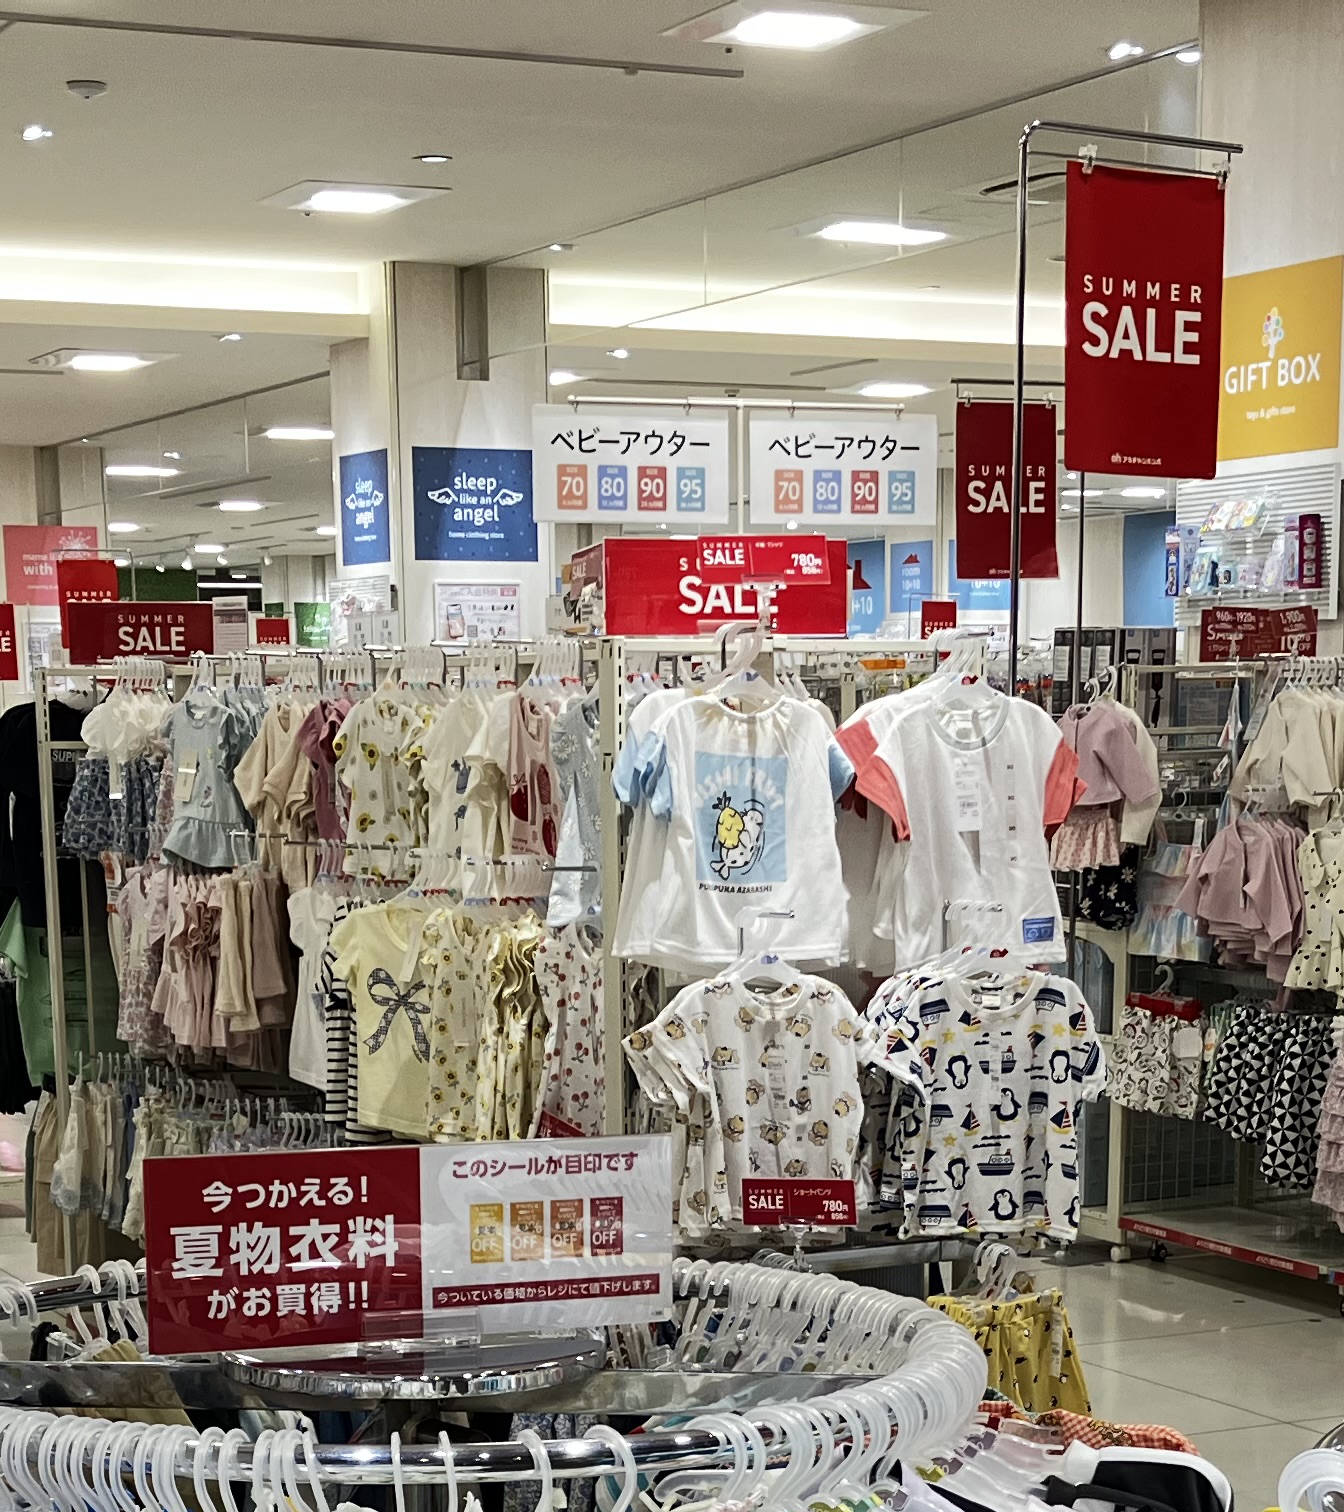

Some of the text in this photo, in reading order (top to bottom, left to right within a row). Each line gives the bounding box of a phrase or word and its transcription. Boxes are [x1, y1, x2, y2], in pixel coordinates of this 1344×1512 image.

[1084, 274, 1203, 304] SUMMER
[1081, 301, 1203, 365] SALE
[1224, 352, 1321, 395] GIFT BOX
[551, 427, 710, 457] ベビーアウター
[768, 433, 920, 461] ベビーアウター
[968, 465, 1045, 477] SUMER
[454, 472, 497, 494] sleep
[560, 476, 703, 499] 70 80 90 95
[777, 481, 912, 501] 70 80 90 95
[459, 493, 492, 505] like an
[454, 505, 500, 526] angel
[702, 541, 744, 550] SUMMER
[702, 549, 745, 565] SALE
[791, 553, 822, 568] 780円
[24, 563, 53, 576] with
[901, 567, 920, 576] room
[901, 578, 921, 590] 10+10
[678, 575, 779, 615] SALE
[118, 614, 185, 624] SUMMER
[118, 626, 186, 651] SALE
[452, 1151, 638, 1180] このシールが目印です
[202, 1176, 368, 1213] 今つかえる!
[748, 1195, 784, 1209] SALE
[822, 1200, 848, 1212] 780円
[170, 1213, 399, 1280] 夏物衣料
[471, 1239, 499, 1252] OFF
[512, 1235, 537, 1249] OFF
[552, 1233, 577, 1248] OFF
[592, 1231, 617, 1245] OFF
[208, 1281, 369, 1319] がお買得!!
[437, 1279, 655, 1304] 今ついている価格からレジにて値下げします。
